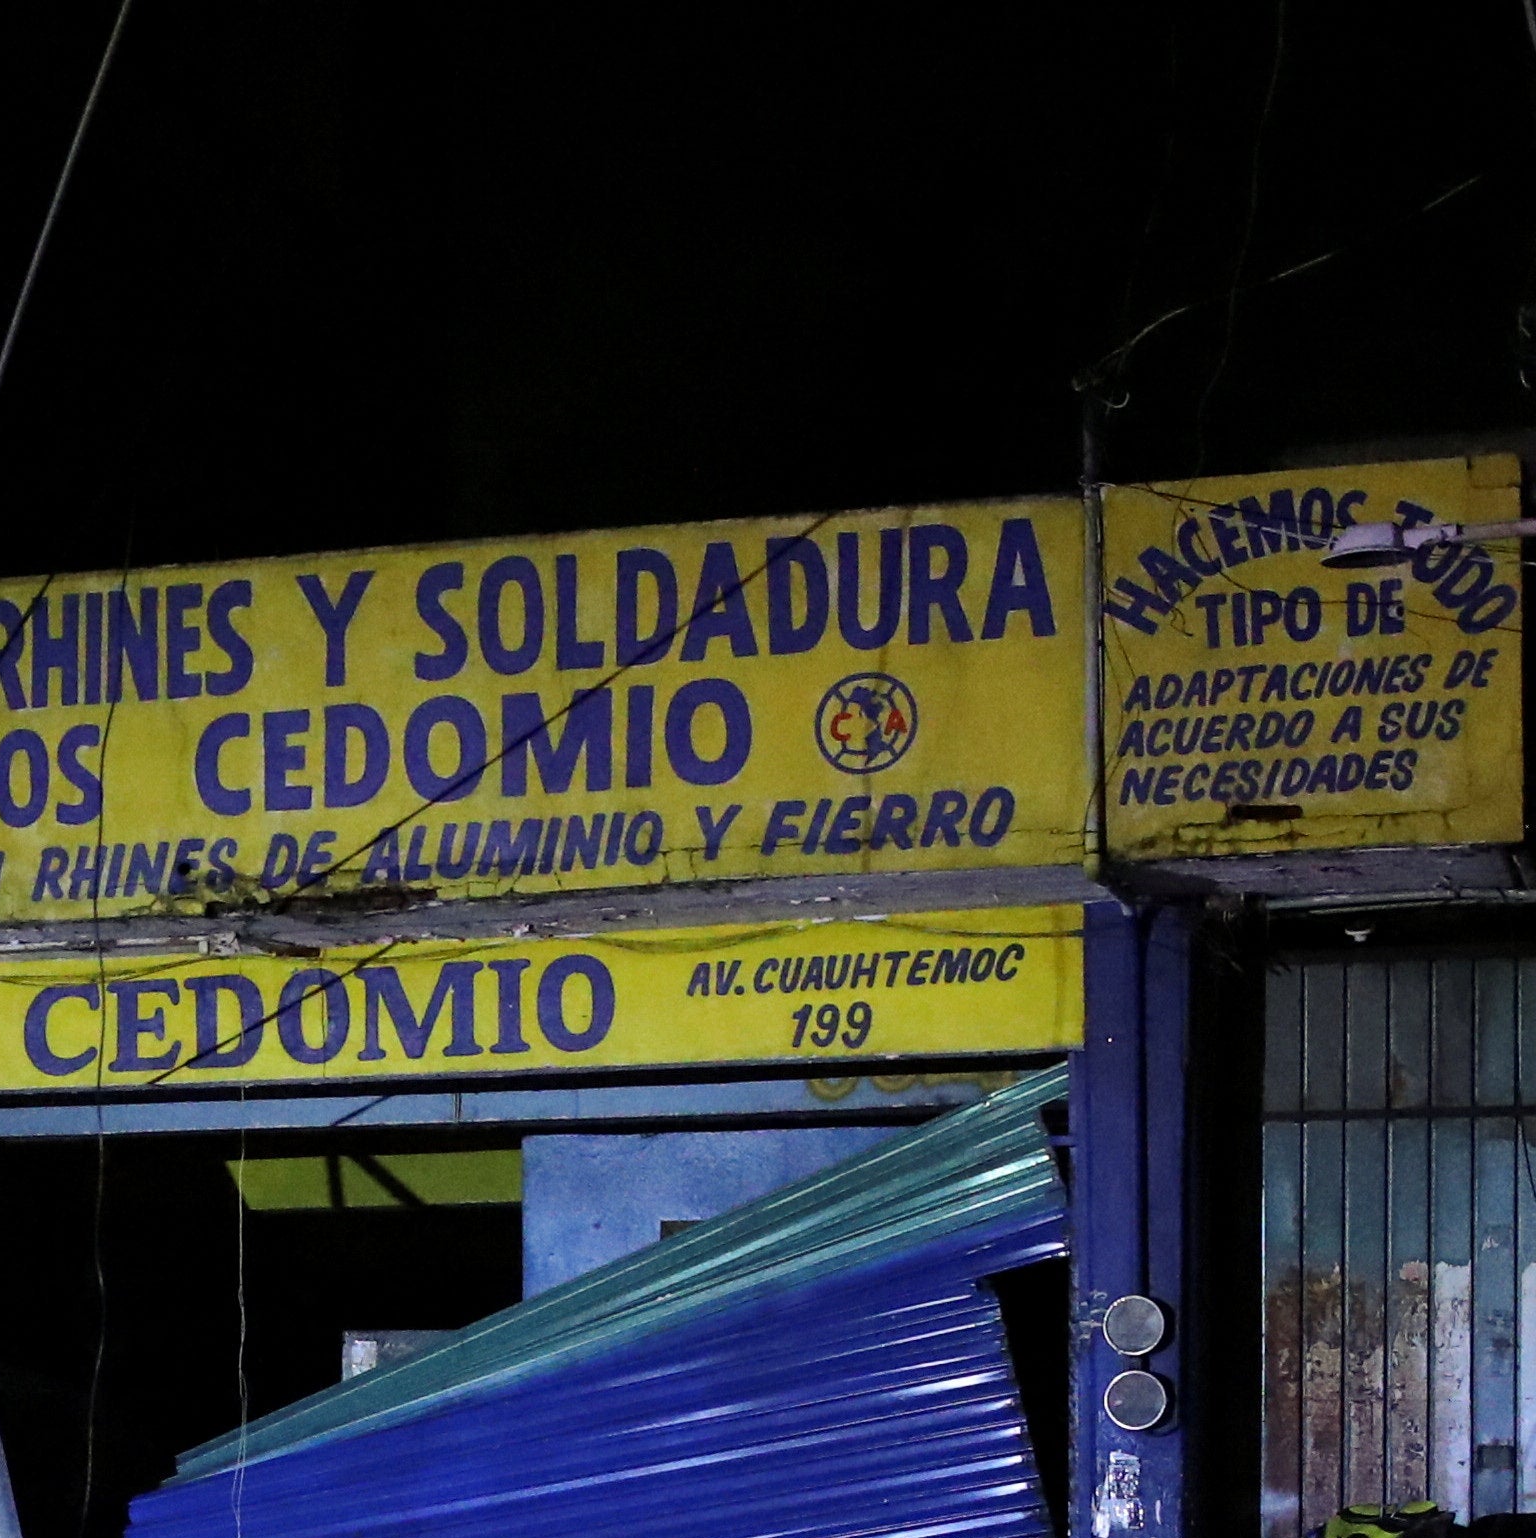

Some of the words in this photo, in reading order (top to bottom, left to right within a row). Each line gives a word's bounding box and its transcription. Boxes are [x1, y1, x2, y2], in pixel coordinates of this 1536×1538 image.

[297, 570, 376, 687] Y
[414, 517, 1056, 683] SOLDADURA
[1103, 487, 1368, 635] HACEMOS
[1395, 500, 1518, 635] TODO
[1195, 587, 1322, 650] TIPO
[1347, 577, 1405, 638] DE
[1123, 653, 1433, 713] ADAPTACIONES
[1444, 648, 1499, 690] DE
[193, 677, 753, 816] CEDOMIO
[1117, 710, 1315, 759] ACUERDO
[1332, 706, 1362, 744] A
[1378, 698, 1466, 743] SUS
[1118, 748, 1418, 807] NECESIDADES
[32, 837, 238, 901] RHINES
[260, 830, 338, 890] DE
[361, 808, 664, 885] ALUMINIO
[697, 804, 741, 861] Y
[761, 785, 1016, 855] FIERRO
[24, 953, 616, 1077] CEDOMIO
[687, 960, 745, 998] AV.
[753, 943, 1026, 992] CUAUHTEMOC
[791, 1000, 873, 1049] 199
